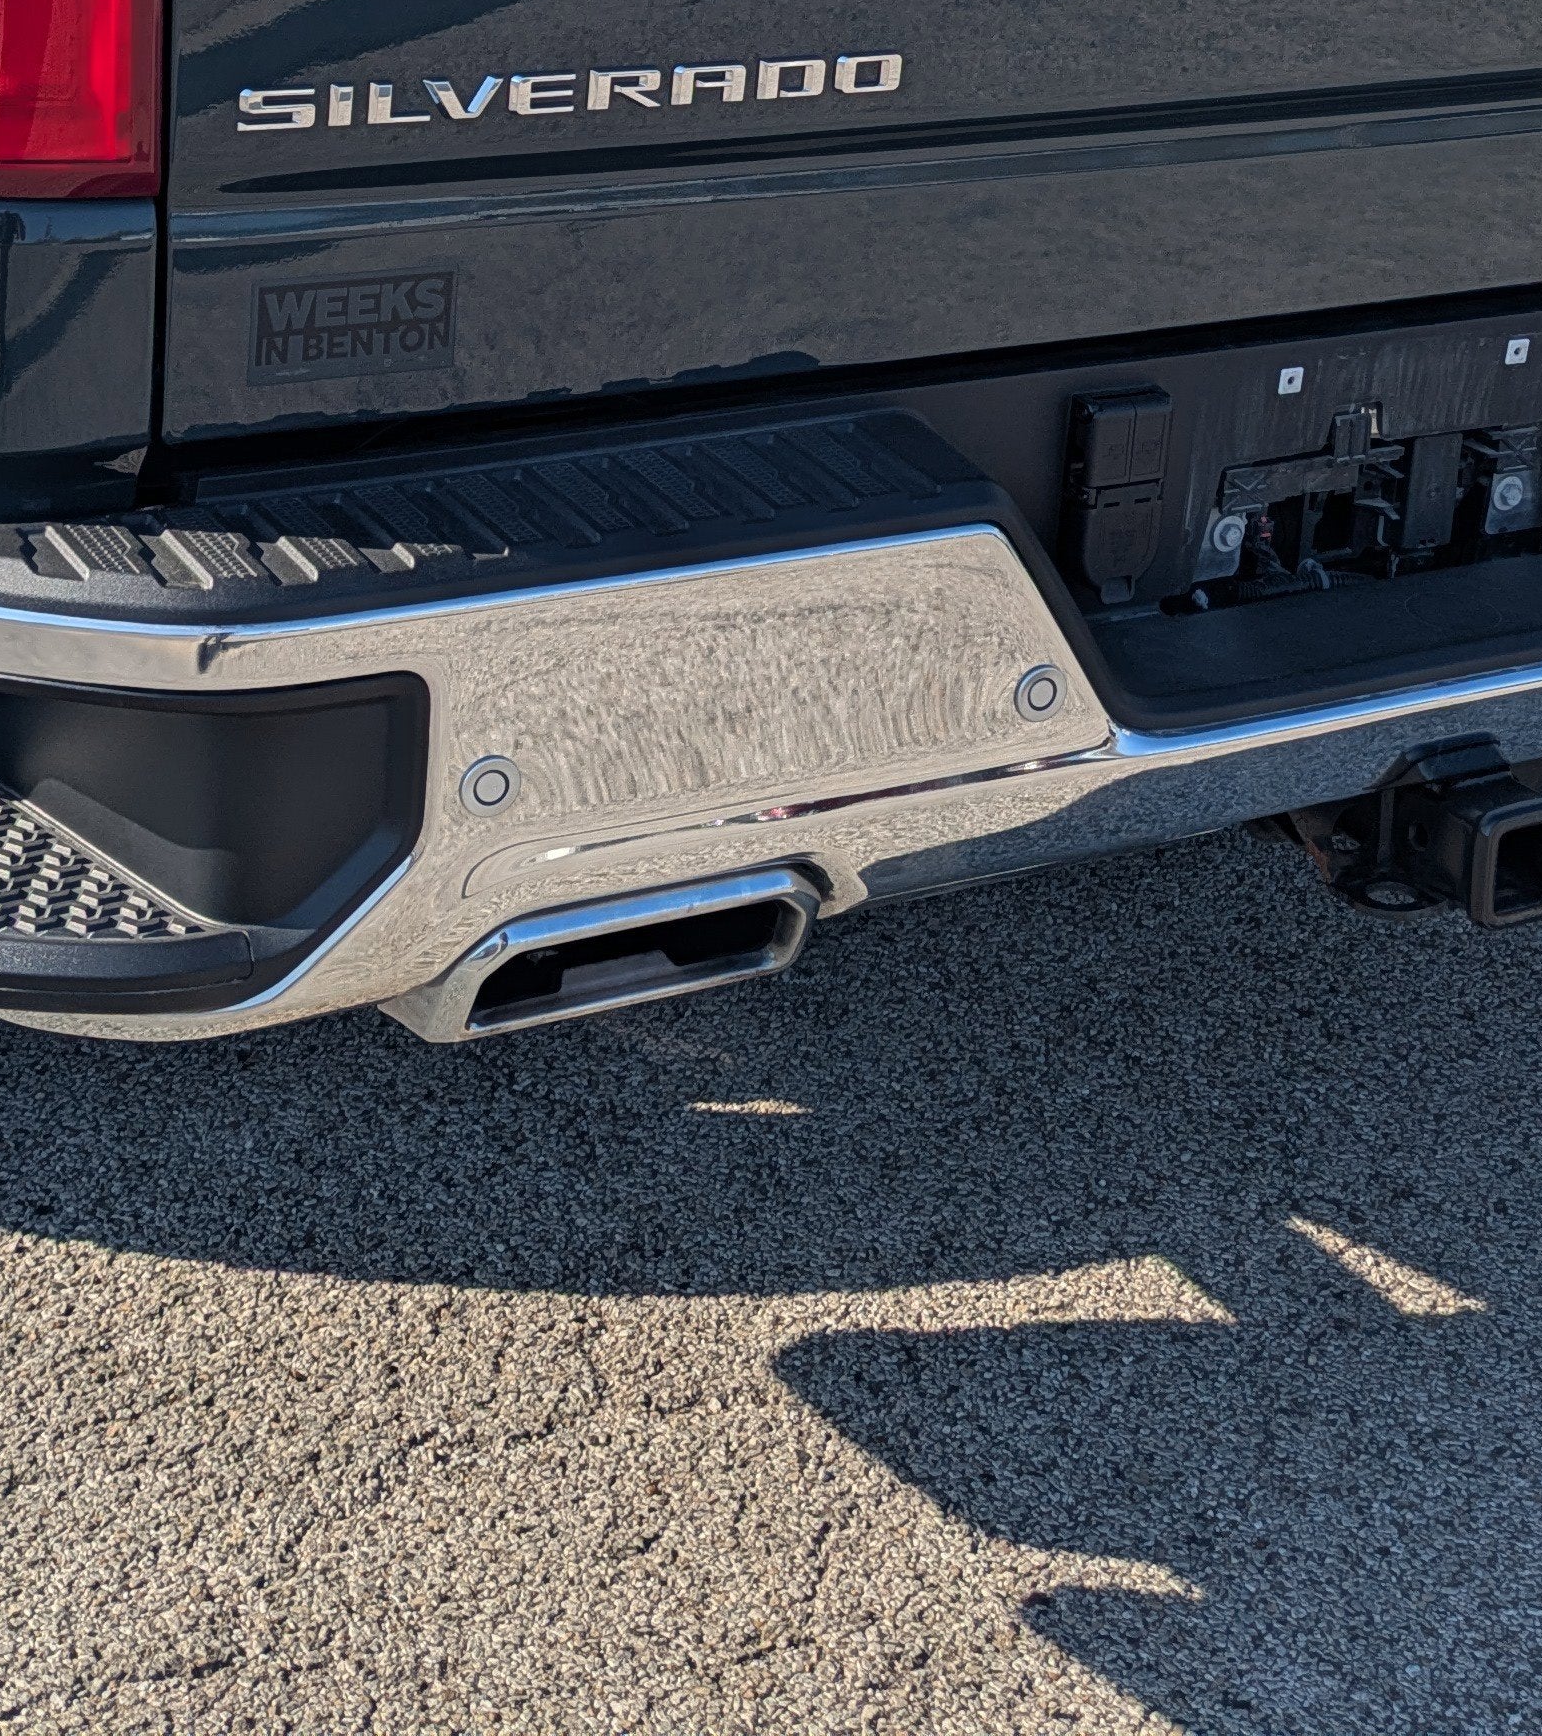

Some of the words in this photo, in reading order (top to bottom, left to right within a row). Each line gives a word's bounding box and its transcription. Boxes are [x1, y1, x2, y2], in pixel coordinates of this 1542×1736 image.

[237, 53, 902, 132] SILVERADO
[264, 278, 447, 332] WEEKS
[301, 320, 449, 363] BENTON
